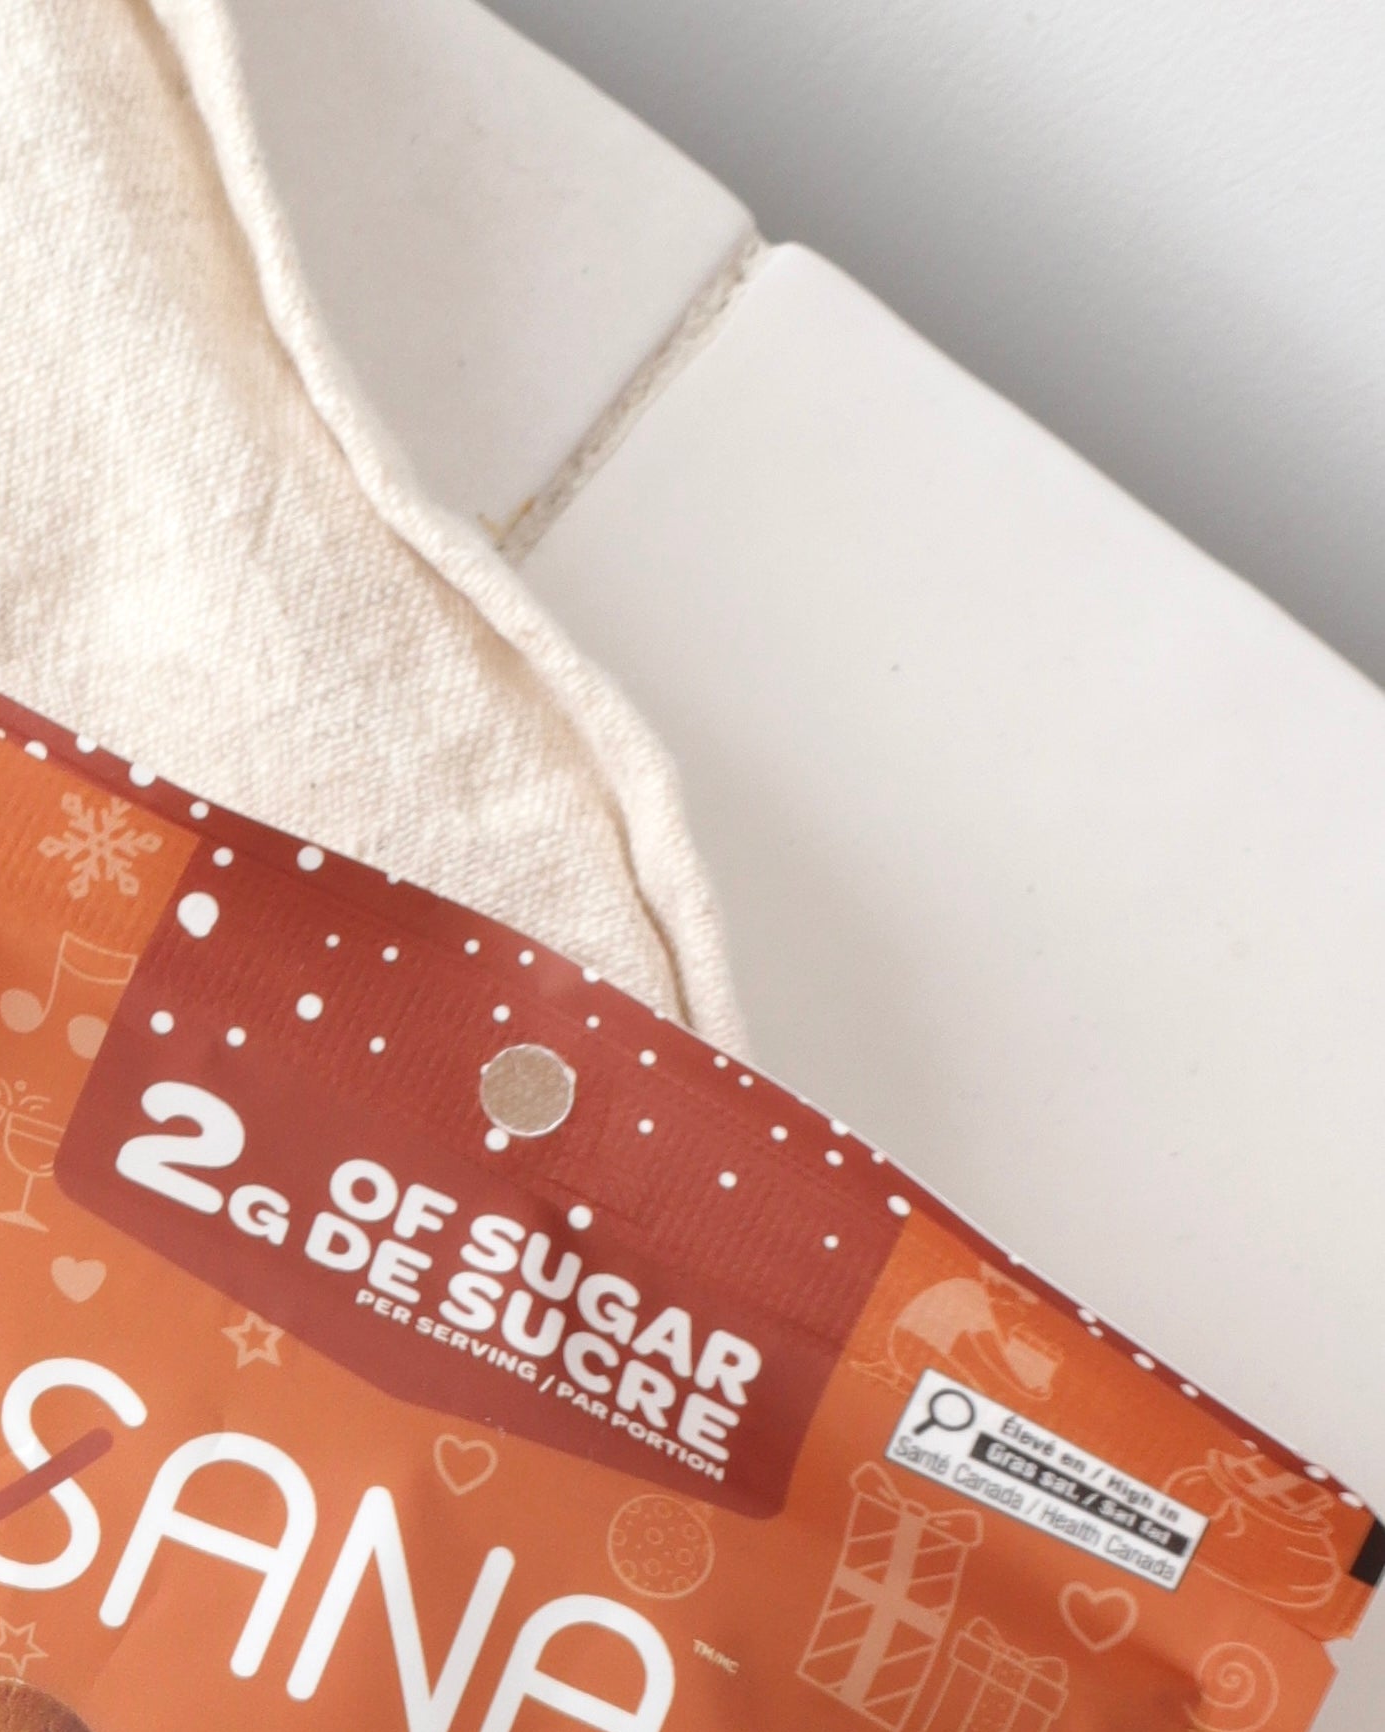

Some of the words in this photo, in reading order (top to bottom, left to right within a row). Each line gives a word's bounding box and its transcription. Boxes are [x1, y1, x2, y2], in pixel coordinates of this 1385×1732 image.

[304, 1211, 433, 1304] DE
[439, 1272, 741, 1461] SUCRE
[329, 1158, 457, 1239] OF
[459, 1214, 762, 1405] SUGAR
[355, 1289, 410, 1324] PER
[415, 1316, 538, 1381] SERVING
[556, 1381, 608, 1421] PAR
[611, 1411, 724, 1481] PORTION
[986, 1442, 1038, 1479] Gras
[1001, 1416, 1055, 1457] Élevé
[1060, 1453, 1087, 1473] en
[1106, 1474, 1154, 1509] High
[1159, 1505, 1180, 1522] in
[895, 1436, 950, 1474] Santé
[953, 1464, 1024, 1509] Canada
[1041, 1504, 1102, 1545] Health
[1104, 1534, 1177, 1581] Canada
